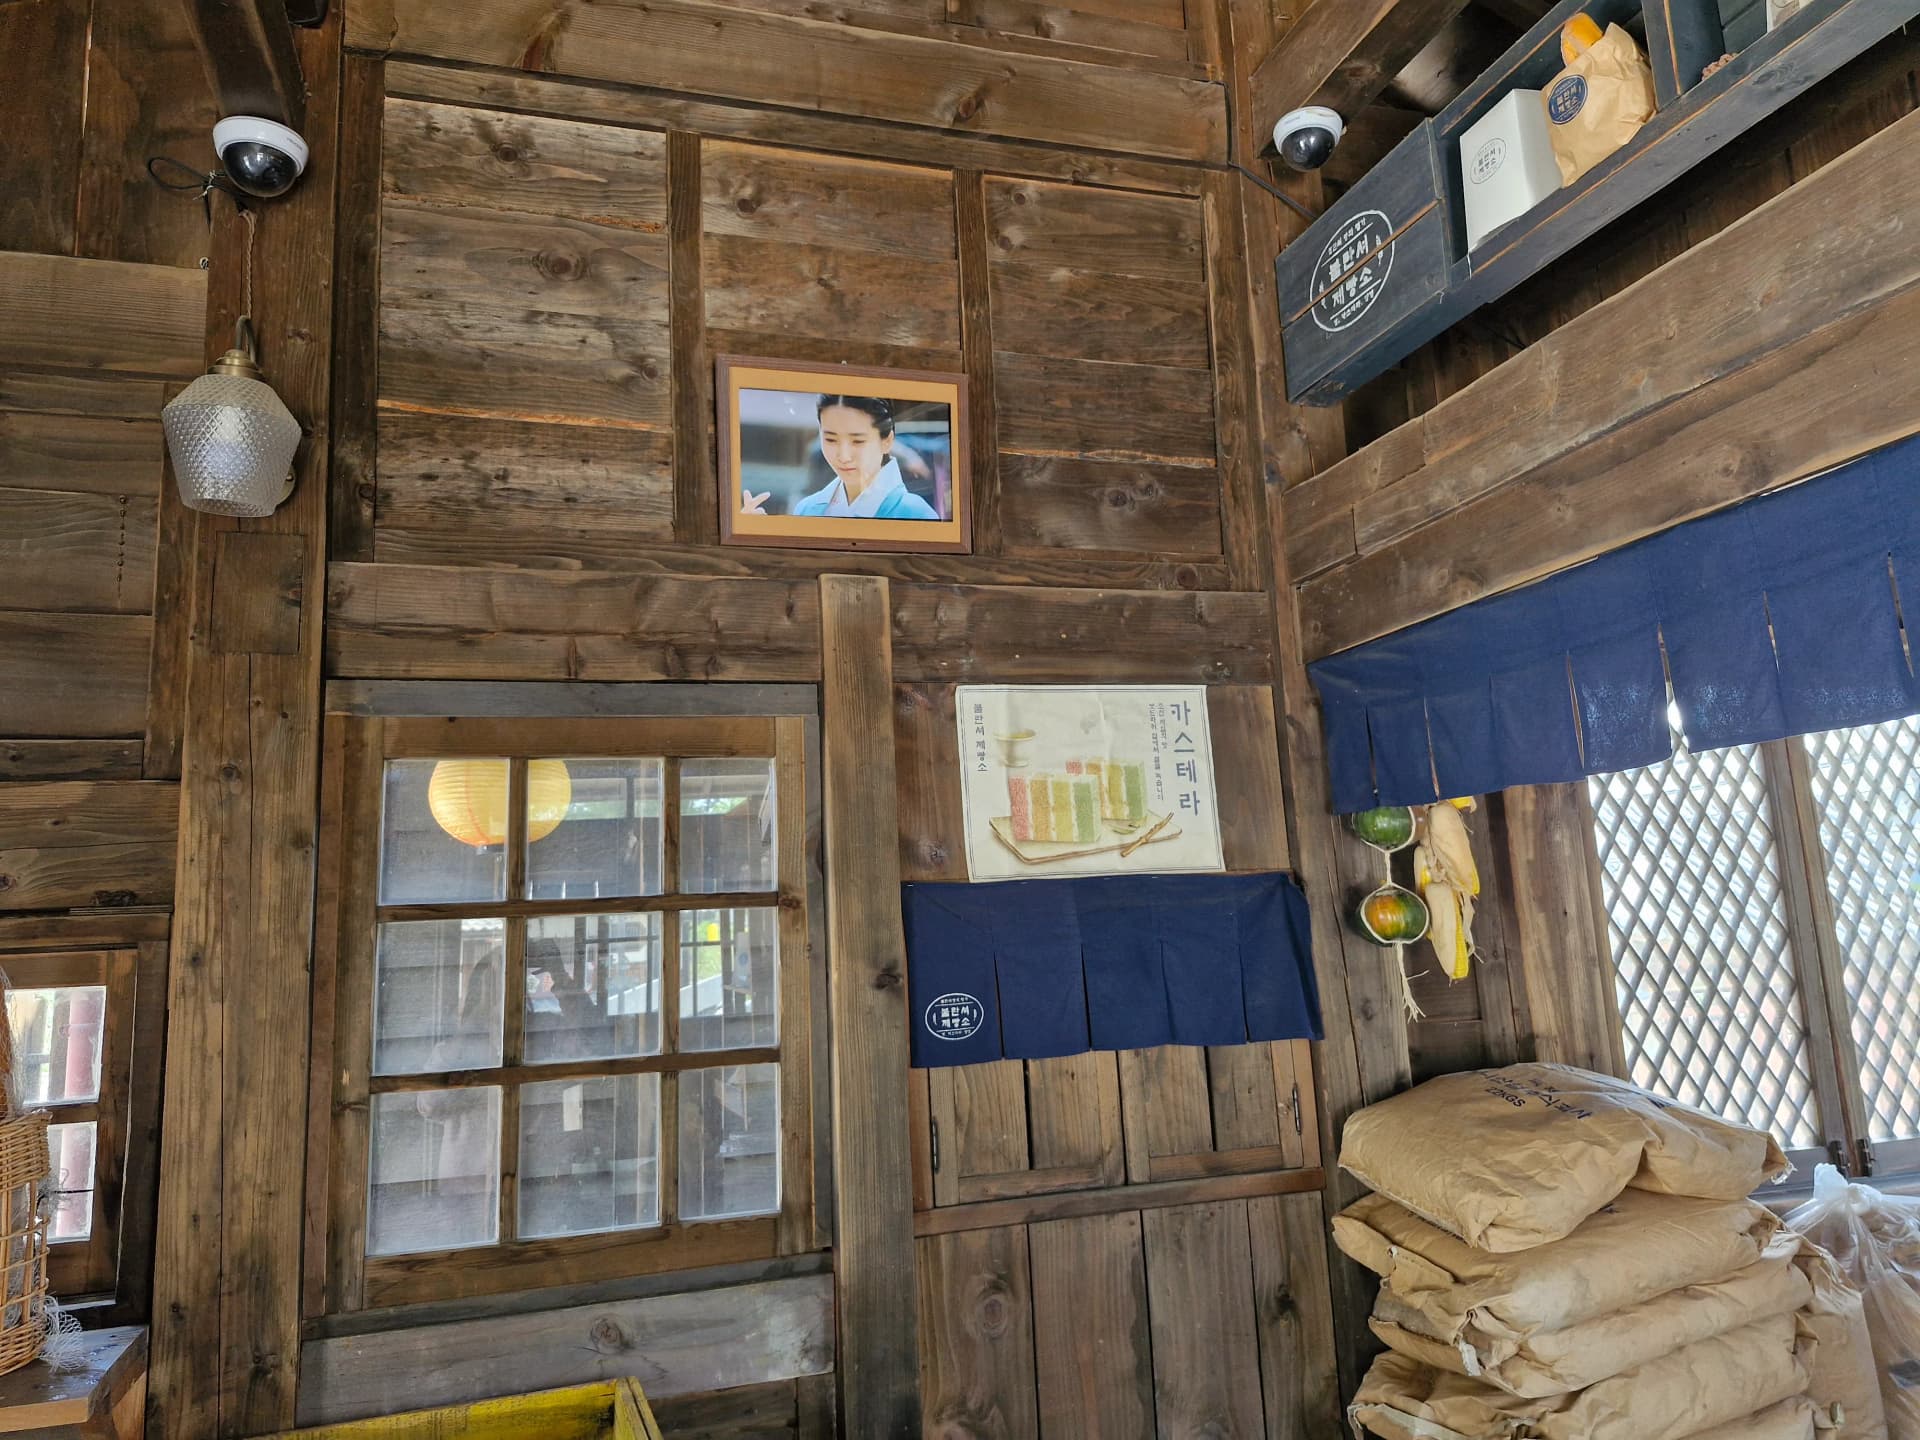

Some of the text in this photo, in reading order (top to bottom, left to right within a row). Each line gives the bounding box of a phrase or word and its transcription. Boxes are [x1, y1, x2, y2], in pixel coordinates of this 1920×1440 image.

[1332, 267, 1373, 308] 제빵소
[1170, 700, 1201, 816] 카스테라
[1485, 1086, 1526, 1107] 22KGS
